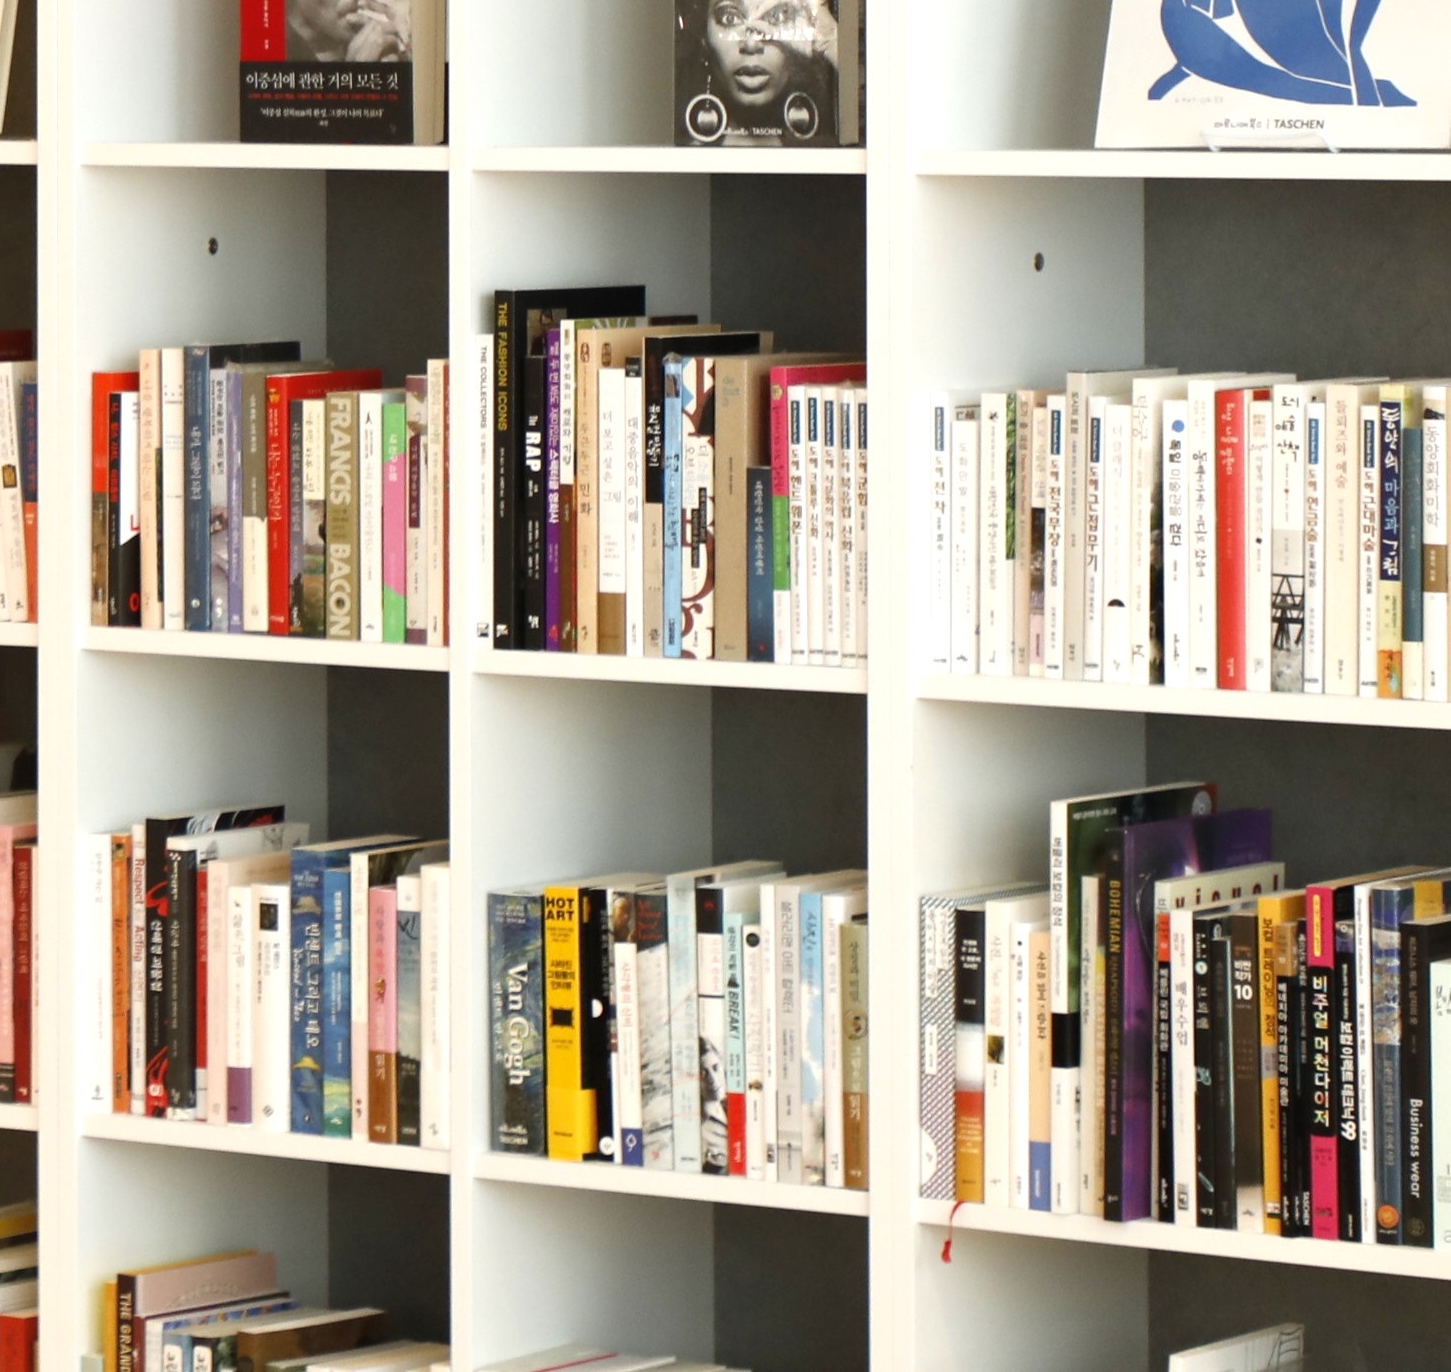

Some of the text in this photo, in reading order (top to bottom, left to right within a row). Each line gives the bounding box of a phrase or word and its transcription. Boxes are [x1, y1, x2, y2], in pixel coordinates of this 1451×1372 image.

[245, 71, 399, 91] 이중섭에 관한 거의 모든 것
[751, 127, 783, 136] TASCHEN
[1273, 118, 1326, 131] TASCHEN
[480, 346, 489, 428] THE COLLECTORS
[497, 302, 509, 431] THE FASHION ICONS
[524, 430, 542, 472] RAP
[328, 397, 353, 637] FRANCIS BACON
[133, 858, 145, 963] Respect Acting
[545, 897, 575, 910] HOT
[545, 910, 575, 922] ART
[1108, 879, 1122, 954] BOHEMIAN
[304, 922, 321, 967] 빈센트
[304, 971, 320, 1014] 그리고
[1234, 984, 1252, 1001] 10
[503, 962, 531, 1086] Van Gogh
[727, 990, 740, 1040] BREAK!
[1311, 975, 1329, 1128] 비주얼 머천다이저
[1339, 1119, 1357, 1141] 99
[1409, 1098, 1424, 1199] Business wear
[1302, 1190, 1311, 1226] TASCHEN
[119, 1292, 131, 1324] THE
